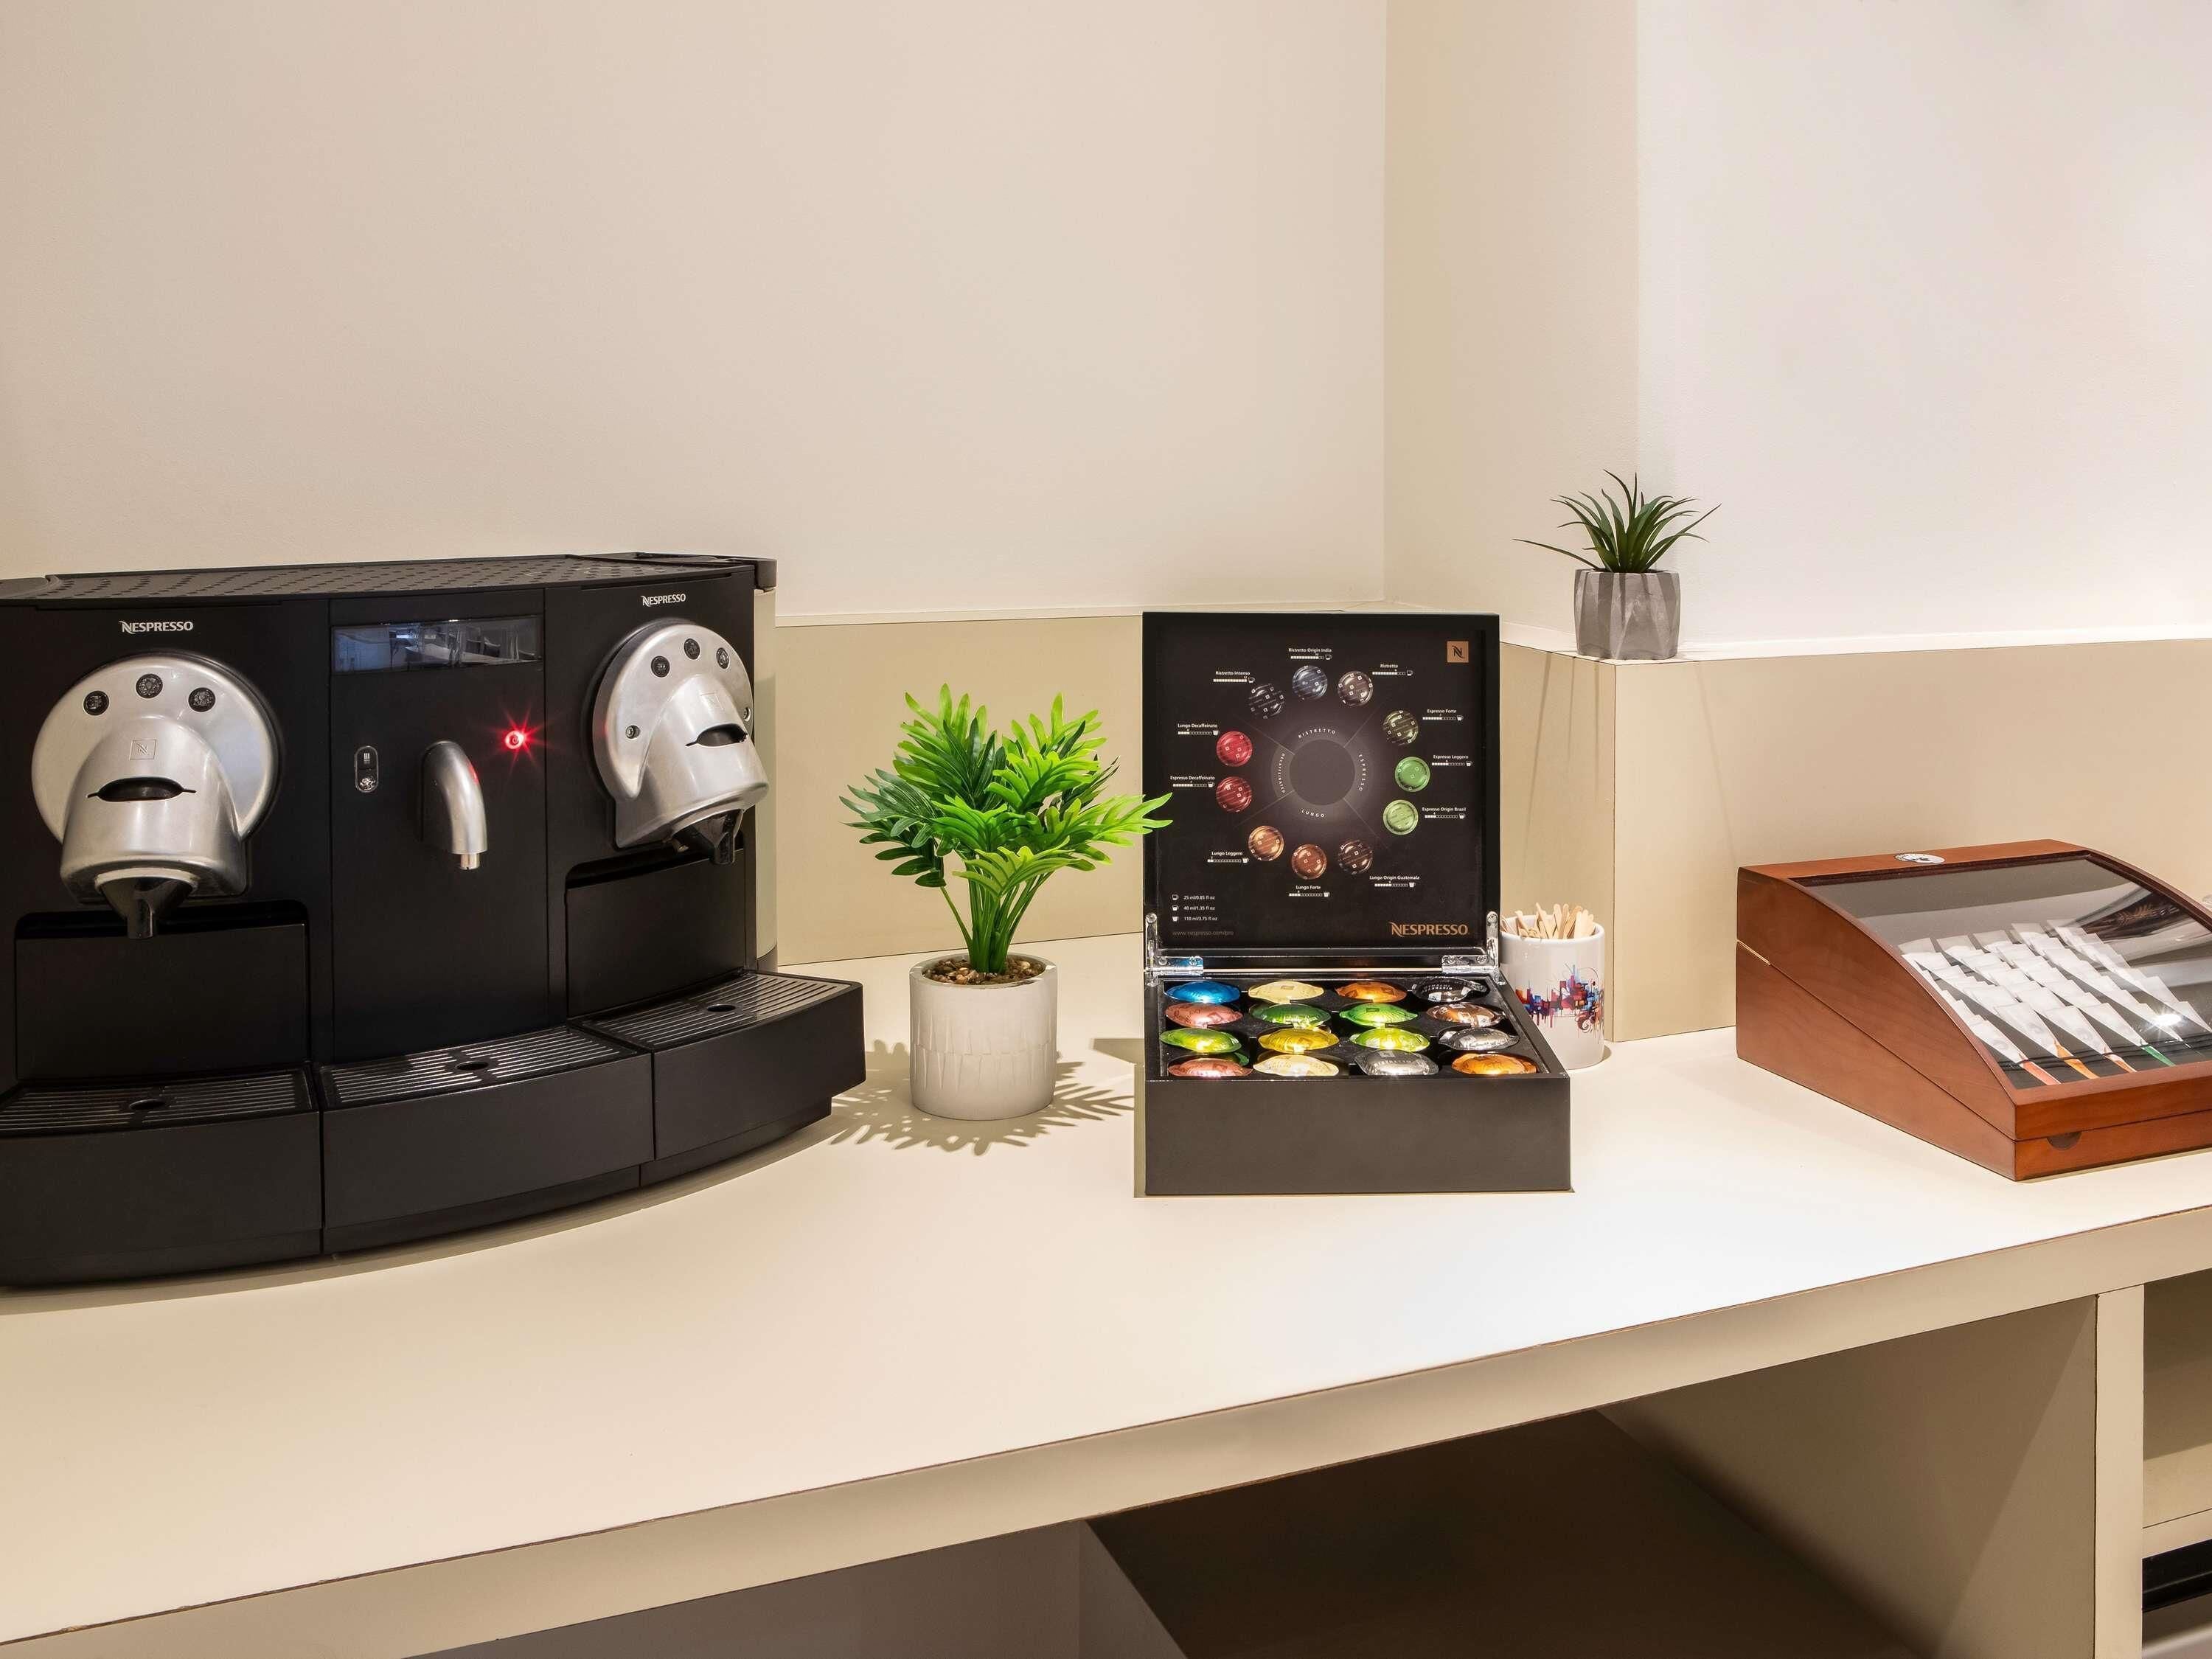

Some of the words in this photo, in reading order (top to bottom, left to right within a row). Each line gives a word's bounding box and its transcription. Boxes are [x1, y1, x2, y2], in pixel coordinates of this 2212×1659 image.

[640, 593, 686, 607] NESPRESSO
[118, 620, 193, 635] NESPRESSO
[1298, 728, 1336, 739] RISTRETTO
[1358, 754, 1366, 791] ESPRESSO
[1301, 809, 1325, 818] LUNGO
[1388, 922, 1469, 938] NESPRESSO
